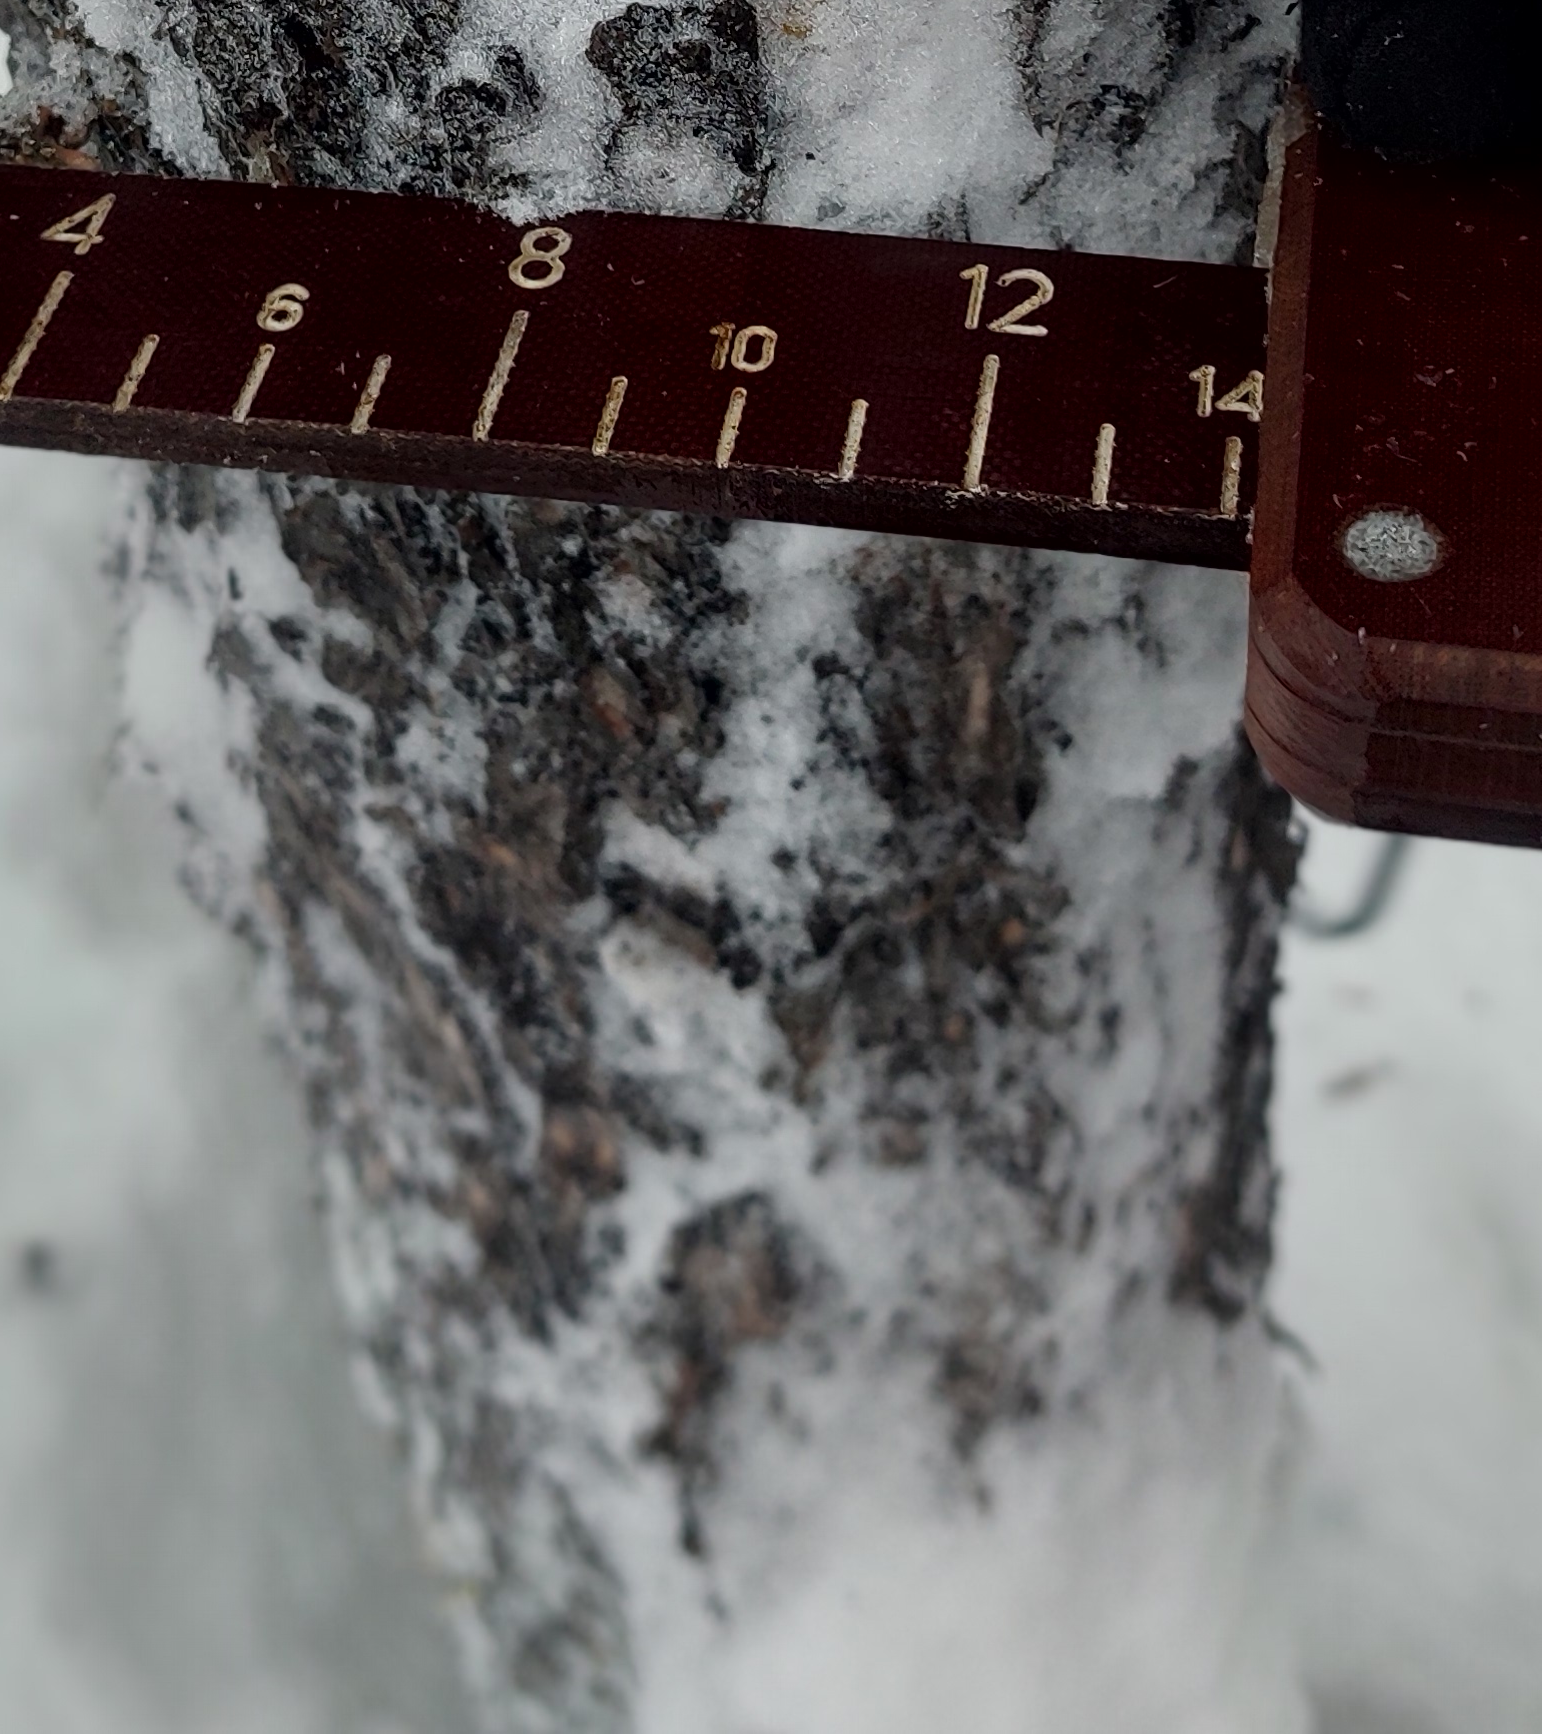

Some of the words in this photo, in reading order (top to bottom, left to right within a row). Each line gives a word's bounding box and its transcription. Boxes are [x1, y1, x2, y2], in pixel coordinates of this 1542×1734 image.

[39, 192, 118, 256] 4
[256, 282, 311, 333] 6
[508, 226, 573, 290] 8
[708, 322, 779, 374] 10
[959, 262, 1056, 338] 12
[1189, 363, 1266, 422] 14
